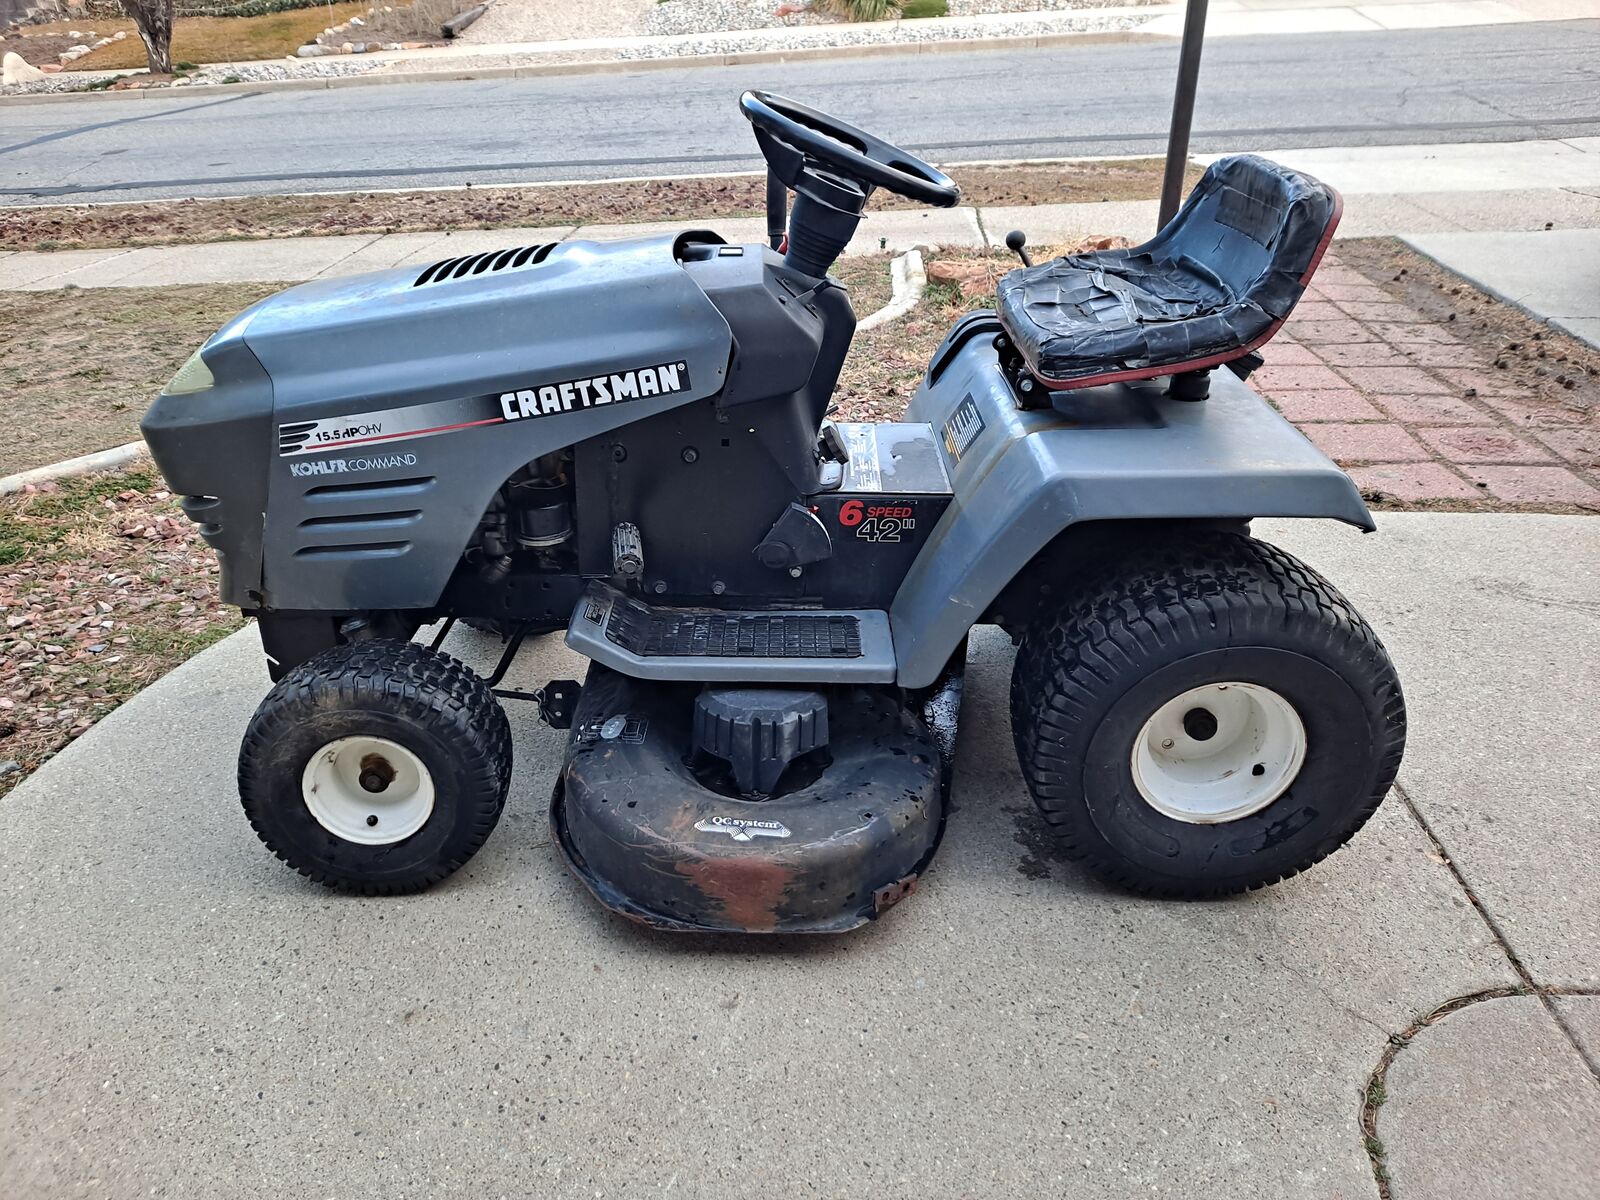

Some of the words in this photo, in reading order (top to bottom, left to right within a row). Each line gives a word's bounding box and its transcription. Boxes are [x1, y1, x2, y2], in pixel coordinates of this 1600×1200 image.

[348, 453, 417, 471] COMMAND
[839, 500, 864, 526] 6
[867, 507, 912, 517] SPEED
